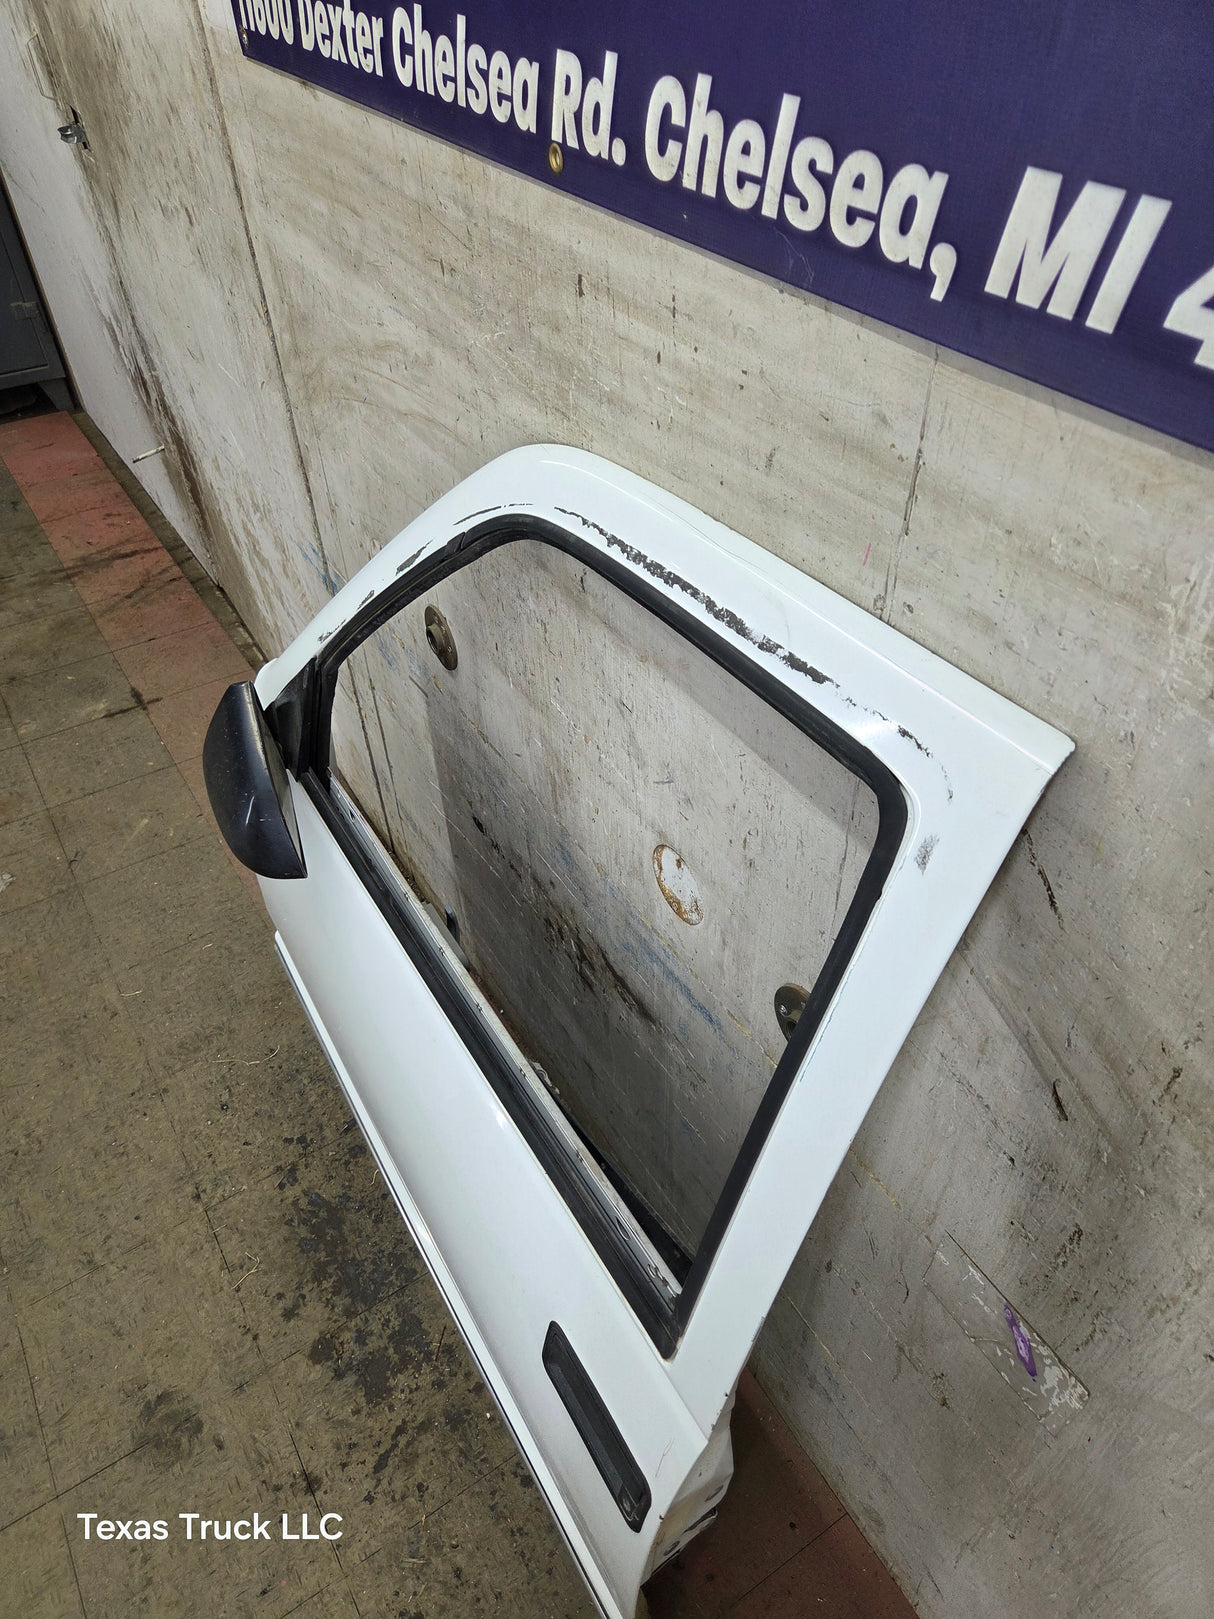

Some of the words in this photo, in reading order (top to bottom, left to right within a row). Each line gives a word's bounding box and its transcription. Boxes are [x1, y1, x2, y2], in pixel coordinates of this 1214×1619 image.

[297, 0, 384, 77] Dexter
[392, 3, 540, 134] Chelsea
[551, 48, 627, 167] Rd.
[644, 73, 957, 303] Chelsea,
[983, 166, 1172, 334] MI
